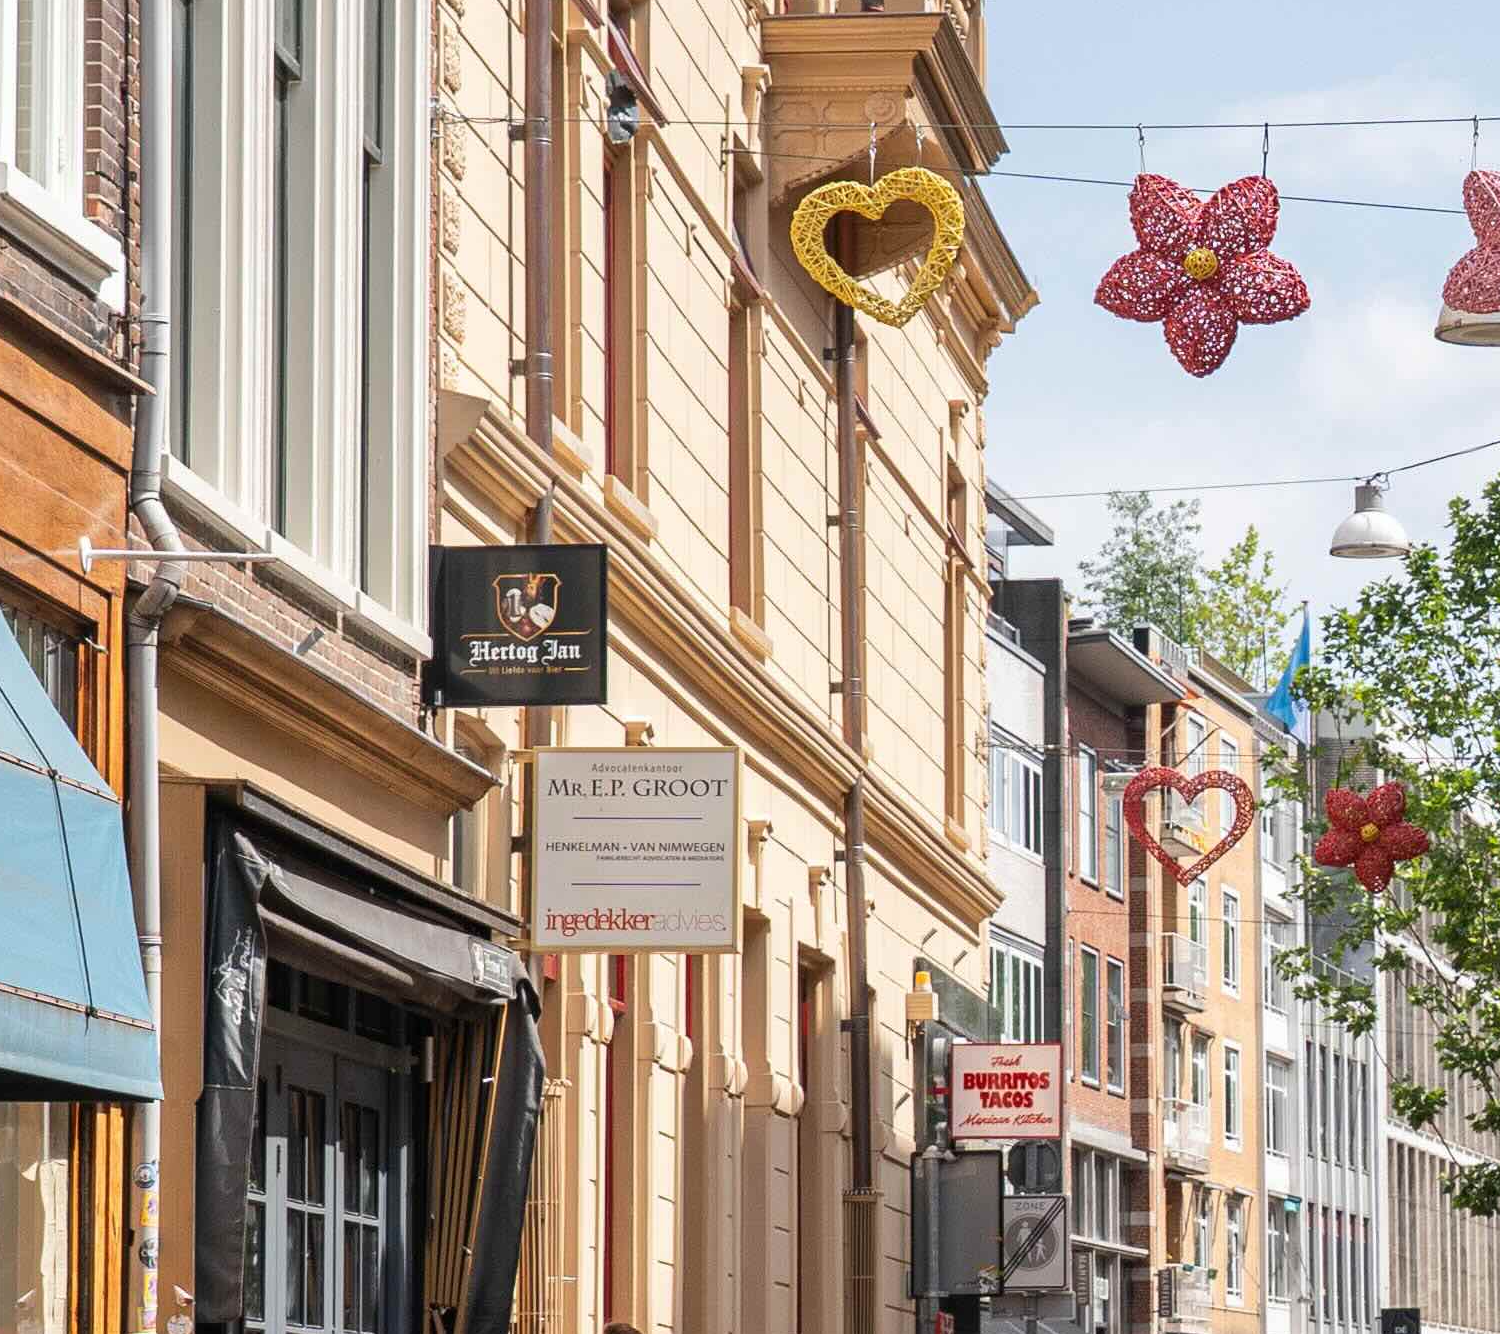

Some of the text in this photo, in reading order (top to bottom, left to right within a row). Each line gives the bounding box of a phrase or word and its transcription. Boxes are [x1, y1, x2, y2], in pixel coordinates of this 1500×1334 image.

[469, 639, 581, 667] Hertog Jan
[592, 778, 626, 798] E.P.
[633, 778, 728, 797] GROOT
[545, 842, 725, 852] HENKELMAN VAN NIMWEGEN
[963, 1071, 1050, 1090] BURRITOS
[979, 1090, 1034, 1109] TACOS
[960, 1114, 1053, 1127] Mexican Kitchen
[1012, 1201, 1046, 1211] ZONE
